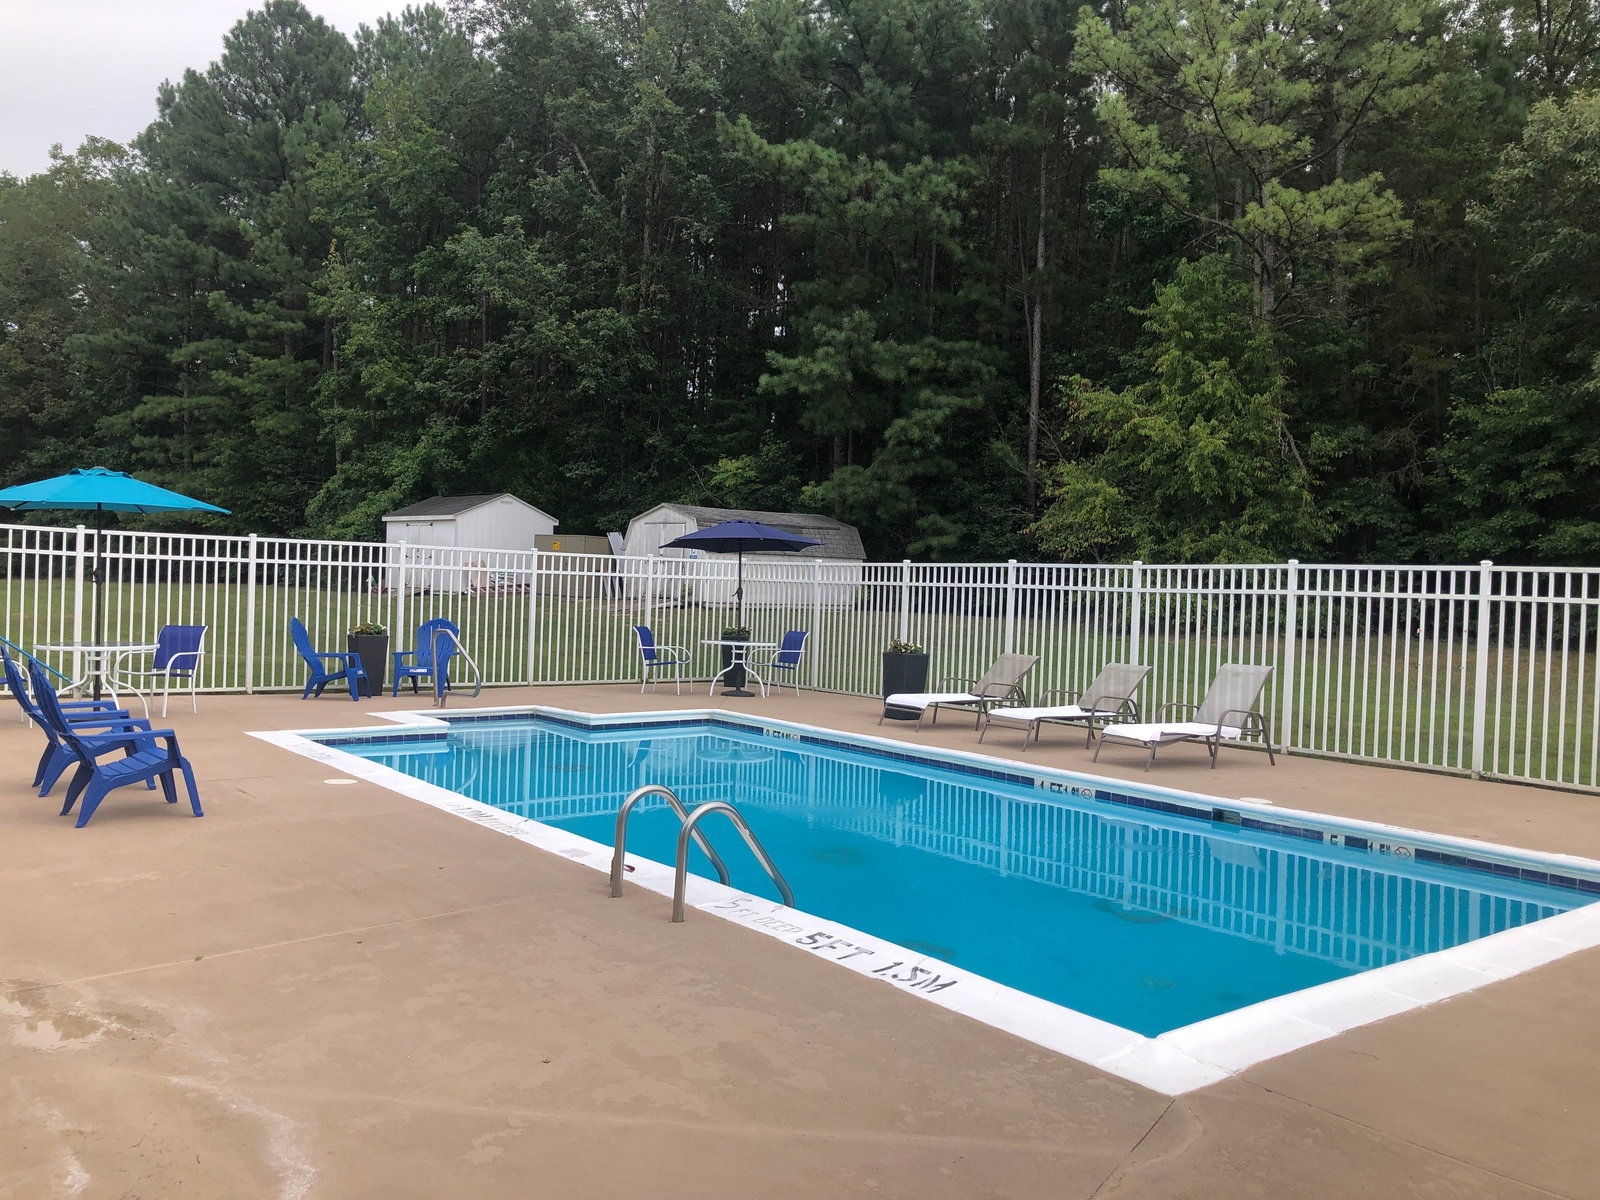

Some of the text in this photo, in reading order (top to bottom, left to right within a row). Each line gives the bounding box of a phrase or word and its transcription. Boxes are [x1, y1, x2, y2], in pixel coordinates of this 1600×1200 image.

[713, 898, 752, 909] 5
[796, 932, 958, 993] 5FT 1.5M
